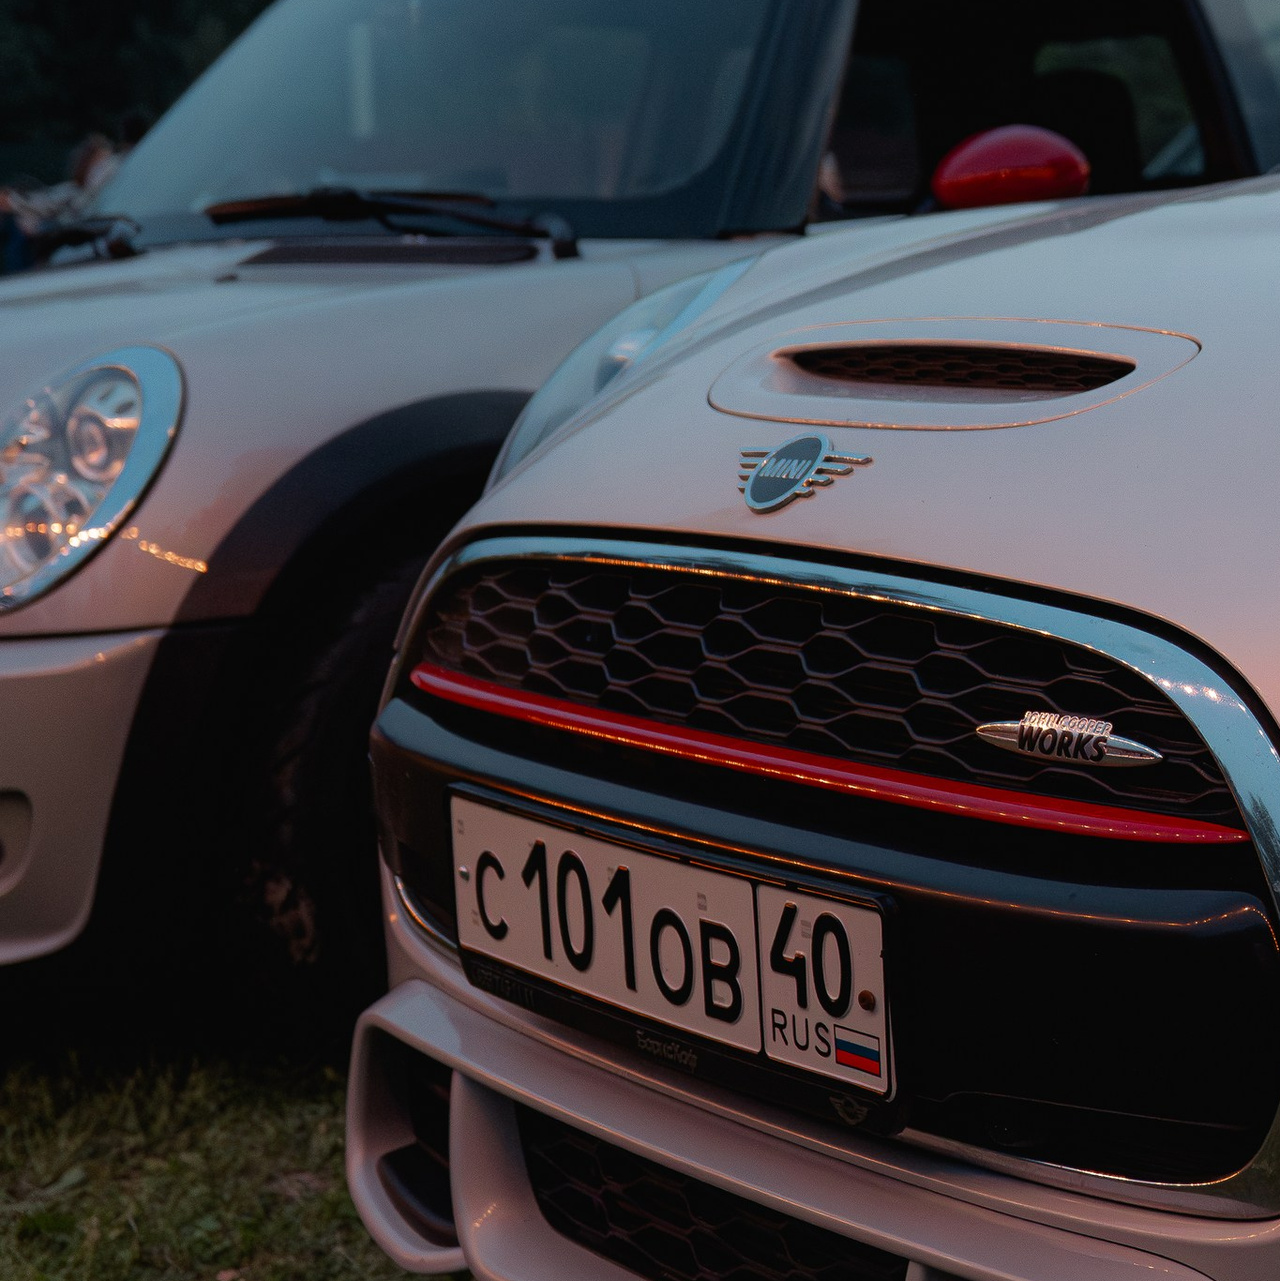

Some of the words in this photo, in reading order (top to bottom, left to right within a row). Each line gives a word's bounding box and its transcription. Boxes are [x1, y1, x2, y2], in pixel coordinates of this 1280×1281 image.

[759, 457, 812, 480] MINI
[1021, 711, 1059, 730] JOHN
[1060, 715, 1113, 737] COOPER
[1017, 725, 1108, 762] WORKS
[769, 902, 852, 1019] 40
[771, 1008, 832, 1058] RUS
